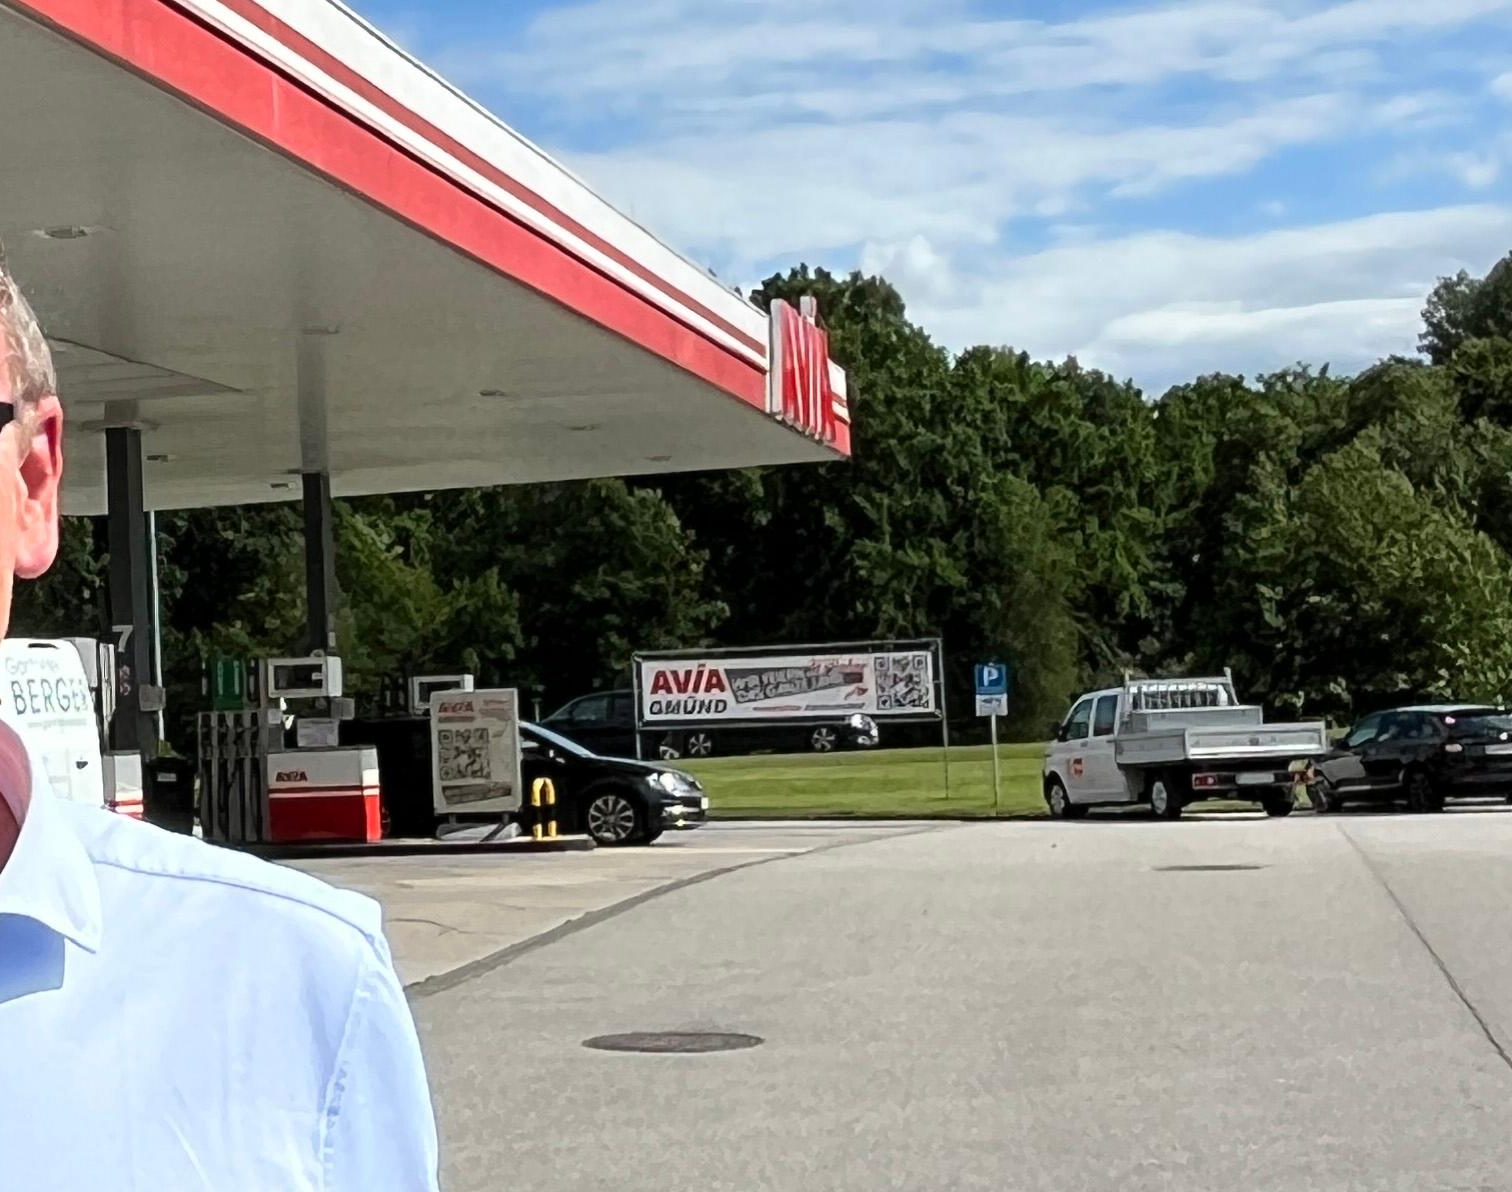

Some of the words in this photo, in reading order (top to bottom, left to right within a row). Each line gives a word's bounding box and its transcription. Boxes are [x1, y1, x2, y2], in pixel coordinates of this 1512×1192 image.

[112, 624, 134, 653] 7
[649, 663, 727, 695] AVIA
[983, 665, 999, 688] P
